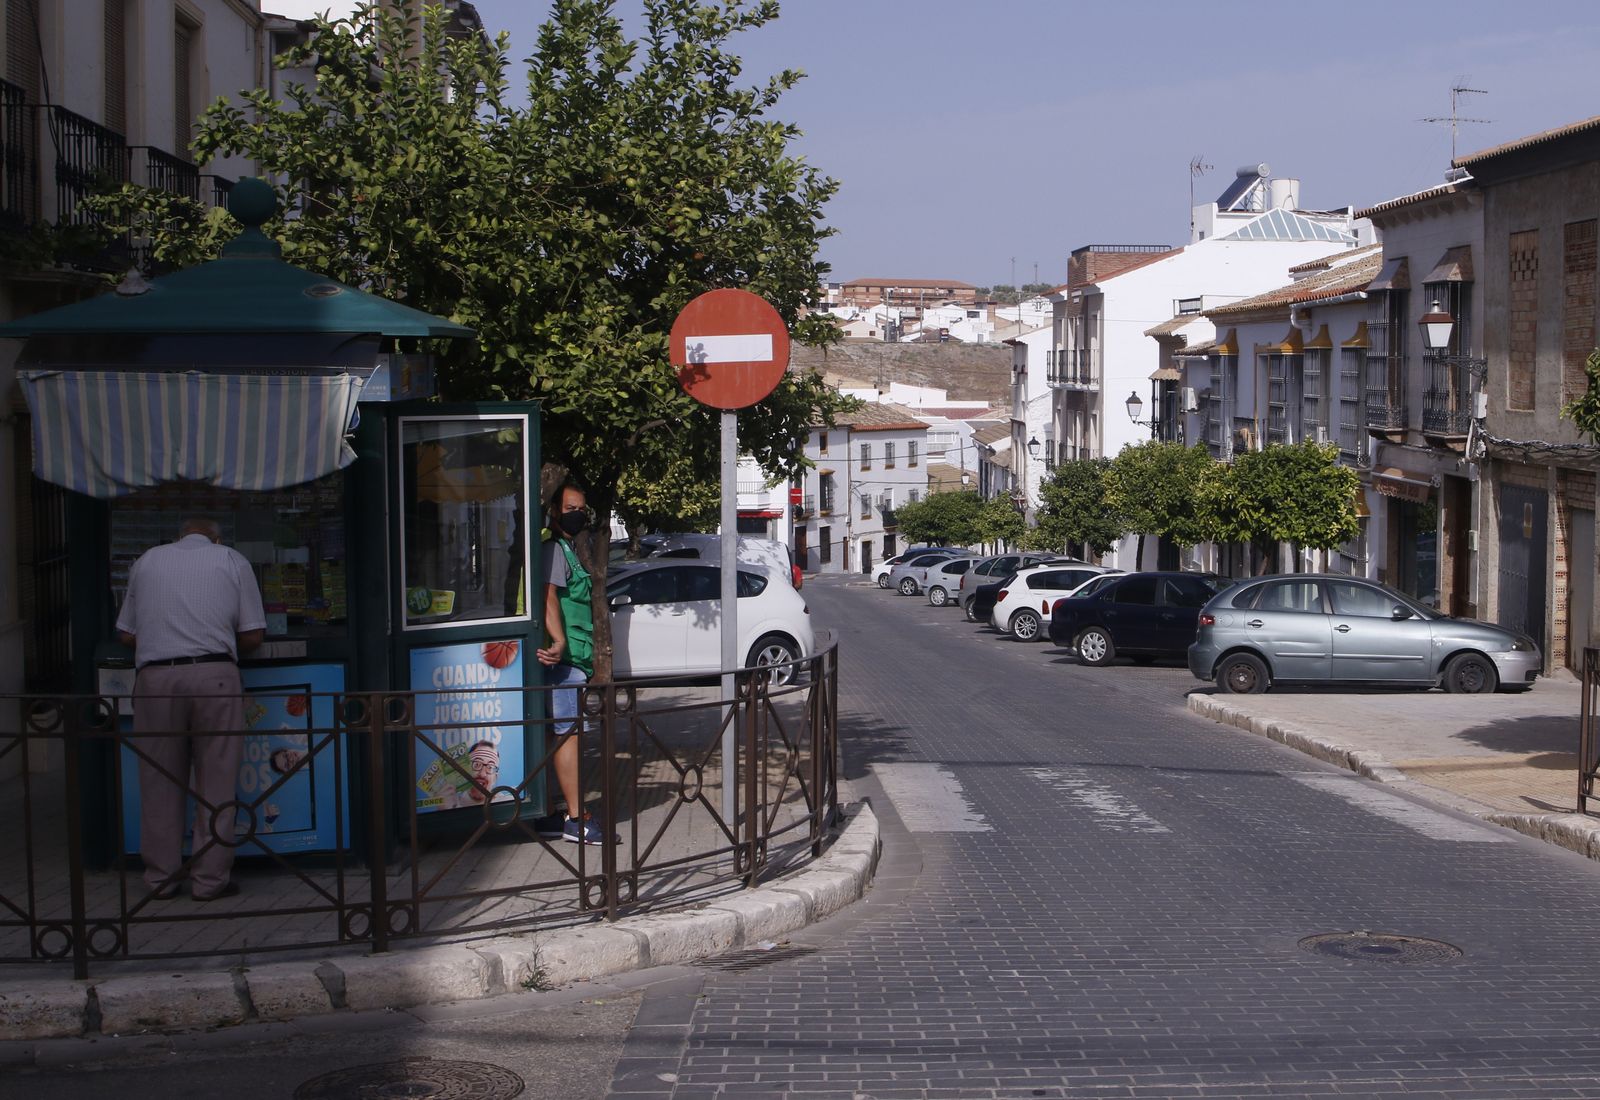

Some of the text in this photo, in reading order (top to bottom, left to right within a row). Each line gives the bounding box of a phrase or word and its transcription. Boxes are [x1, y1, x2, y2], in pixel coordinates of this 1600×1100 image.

[408, 590, 431, 610] +18
[432, 662, 502, 687] CUANDO
[433, 698, 502, 724] JUGAMOS
[432, 720, 502, 751] TODOS
